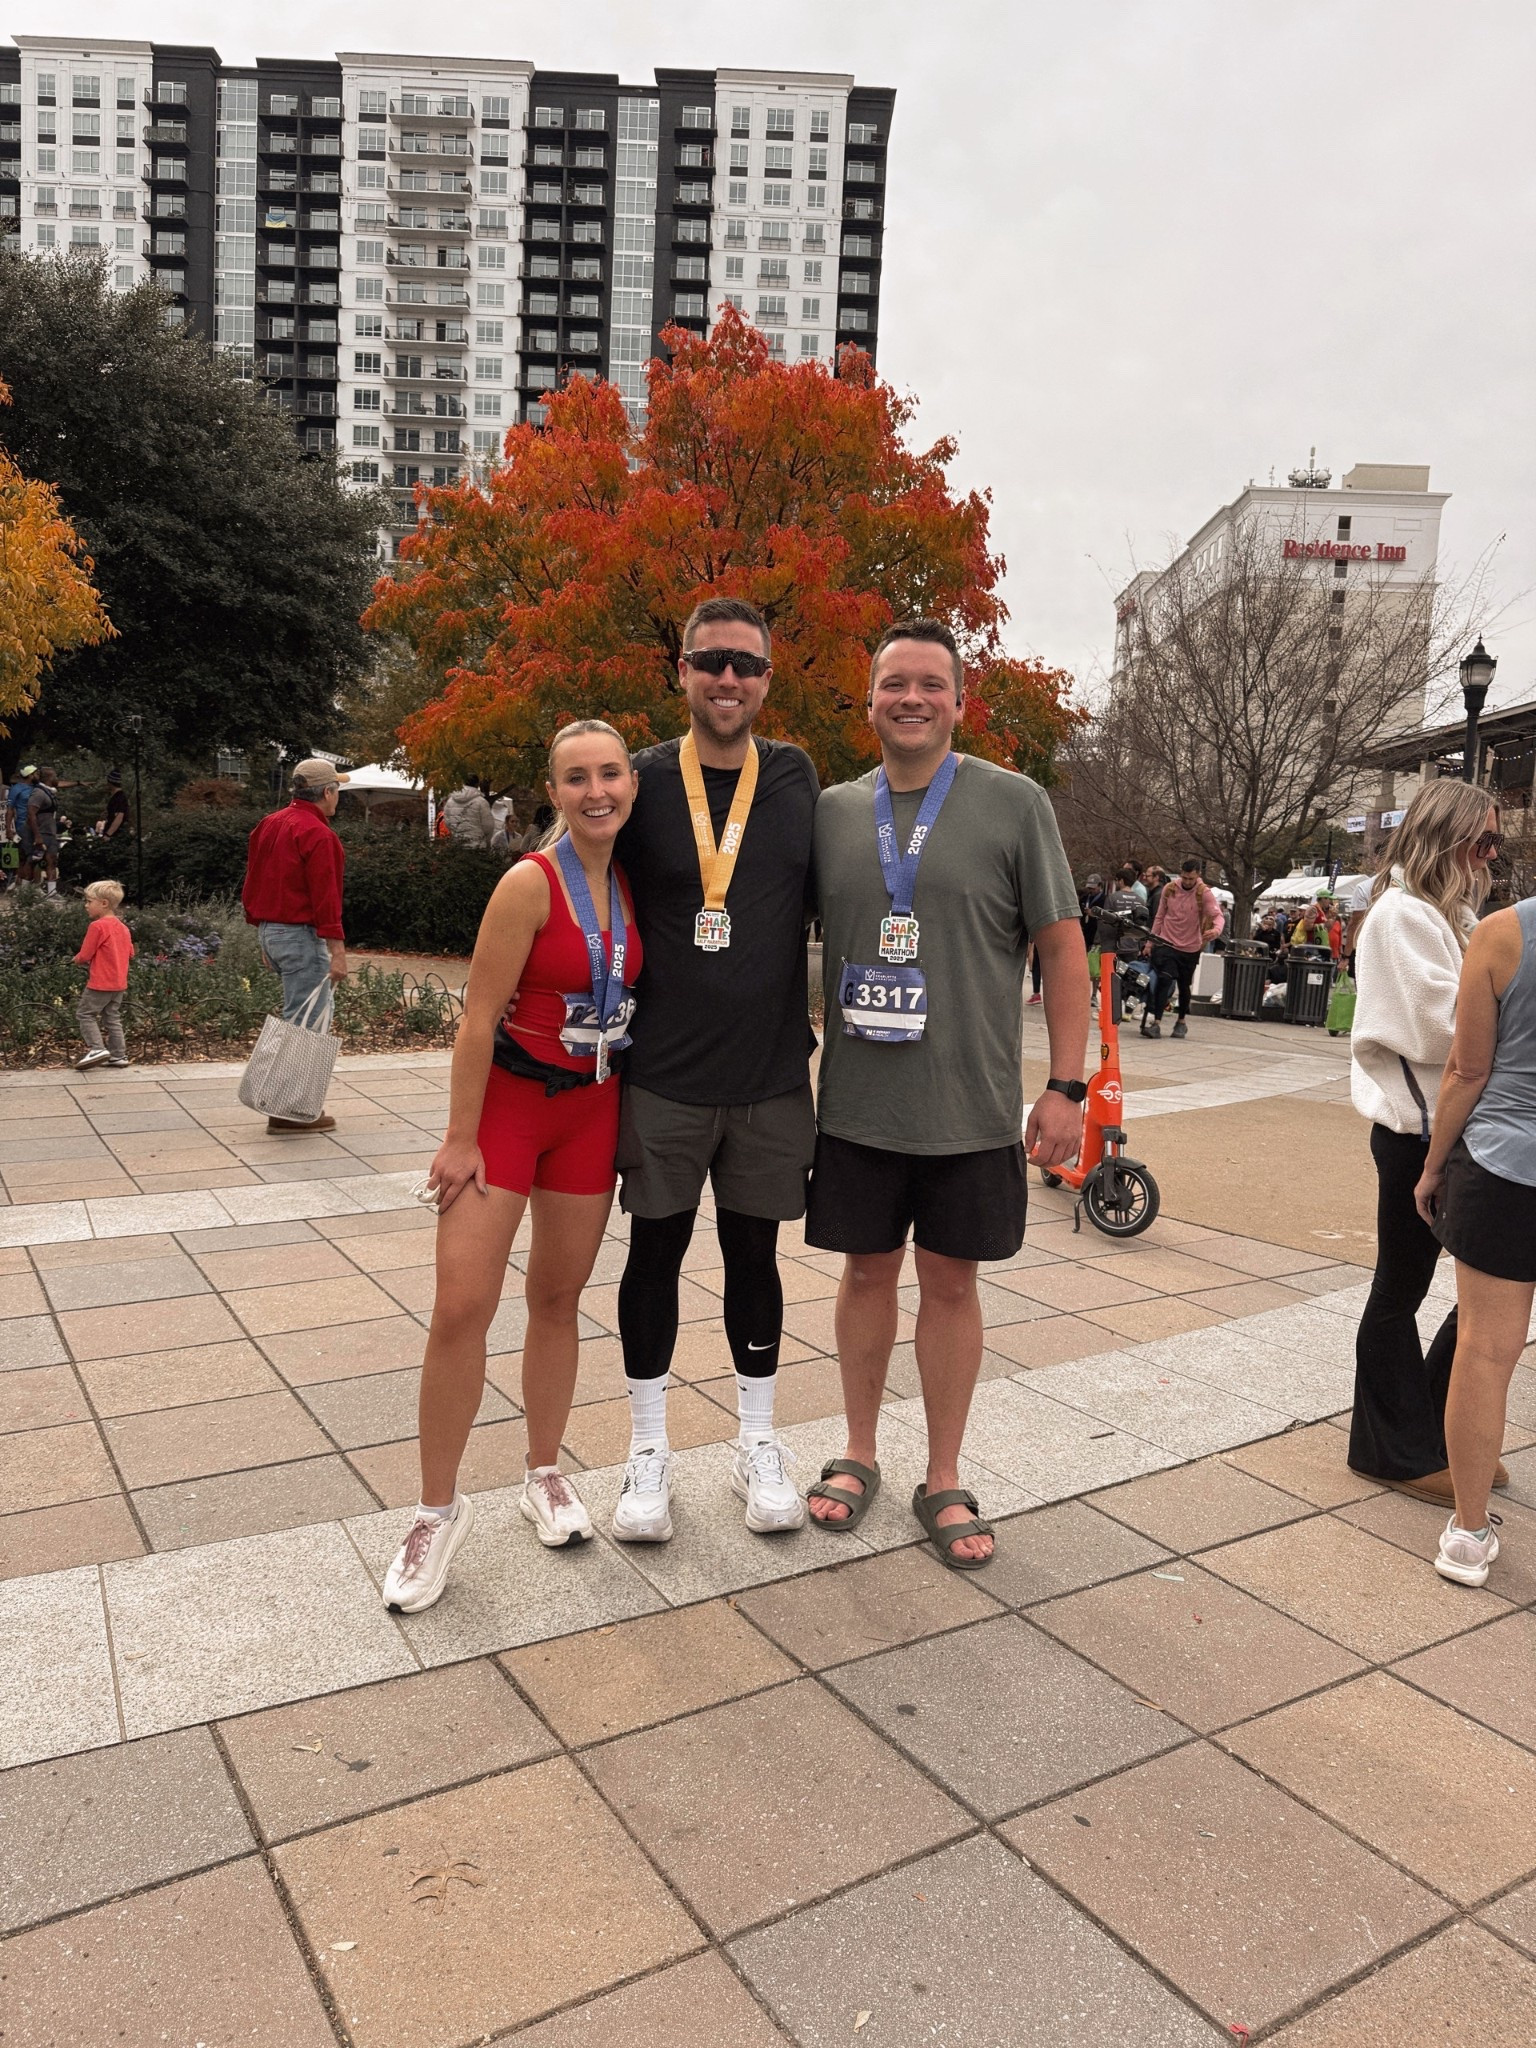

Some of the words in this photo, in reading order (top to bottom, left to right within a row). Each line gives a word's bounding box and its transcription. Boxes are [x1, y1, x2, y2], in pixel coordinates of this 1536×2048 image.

[1283, 540, 1372, 559] Residence
[1376, 543, 1407, 562] Inn
[722, 822, 742, 855] 2025
[907, 825, 928, 855] 2025
[612, 943, 625, 978] 2025
[880, 947, 915, 957] MARATHON
[856, 983, 923, 1010] 3317
[582, 998, 636, 1025] 236
